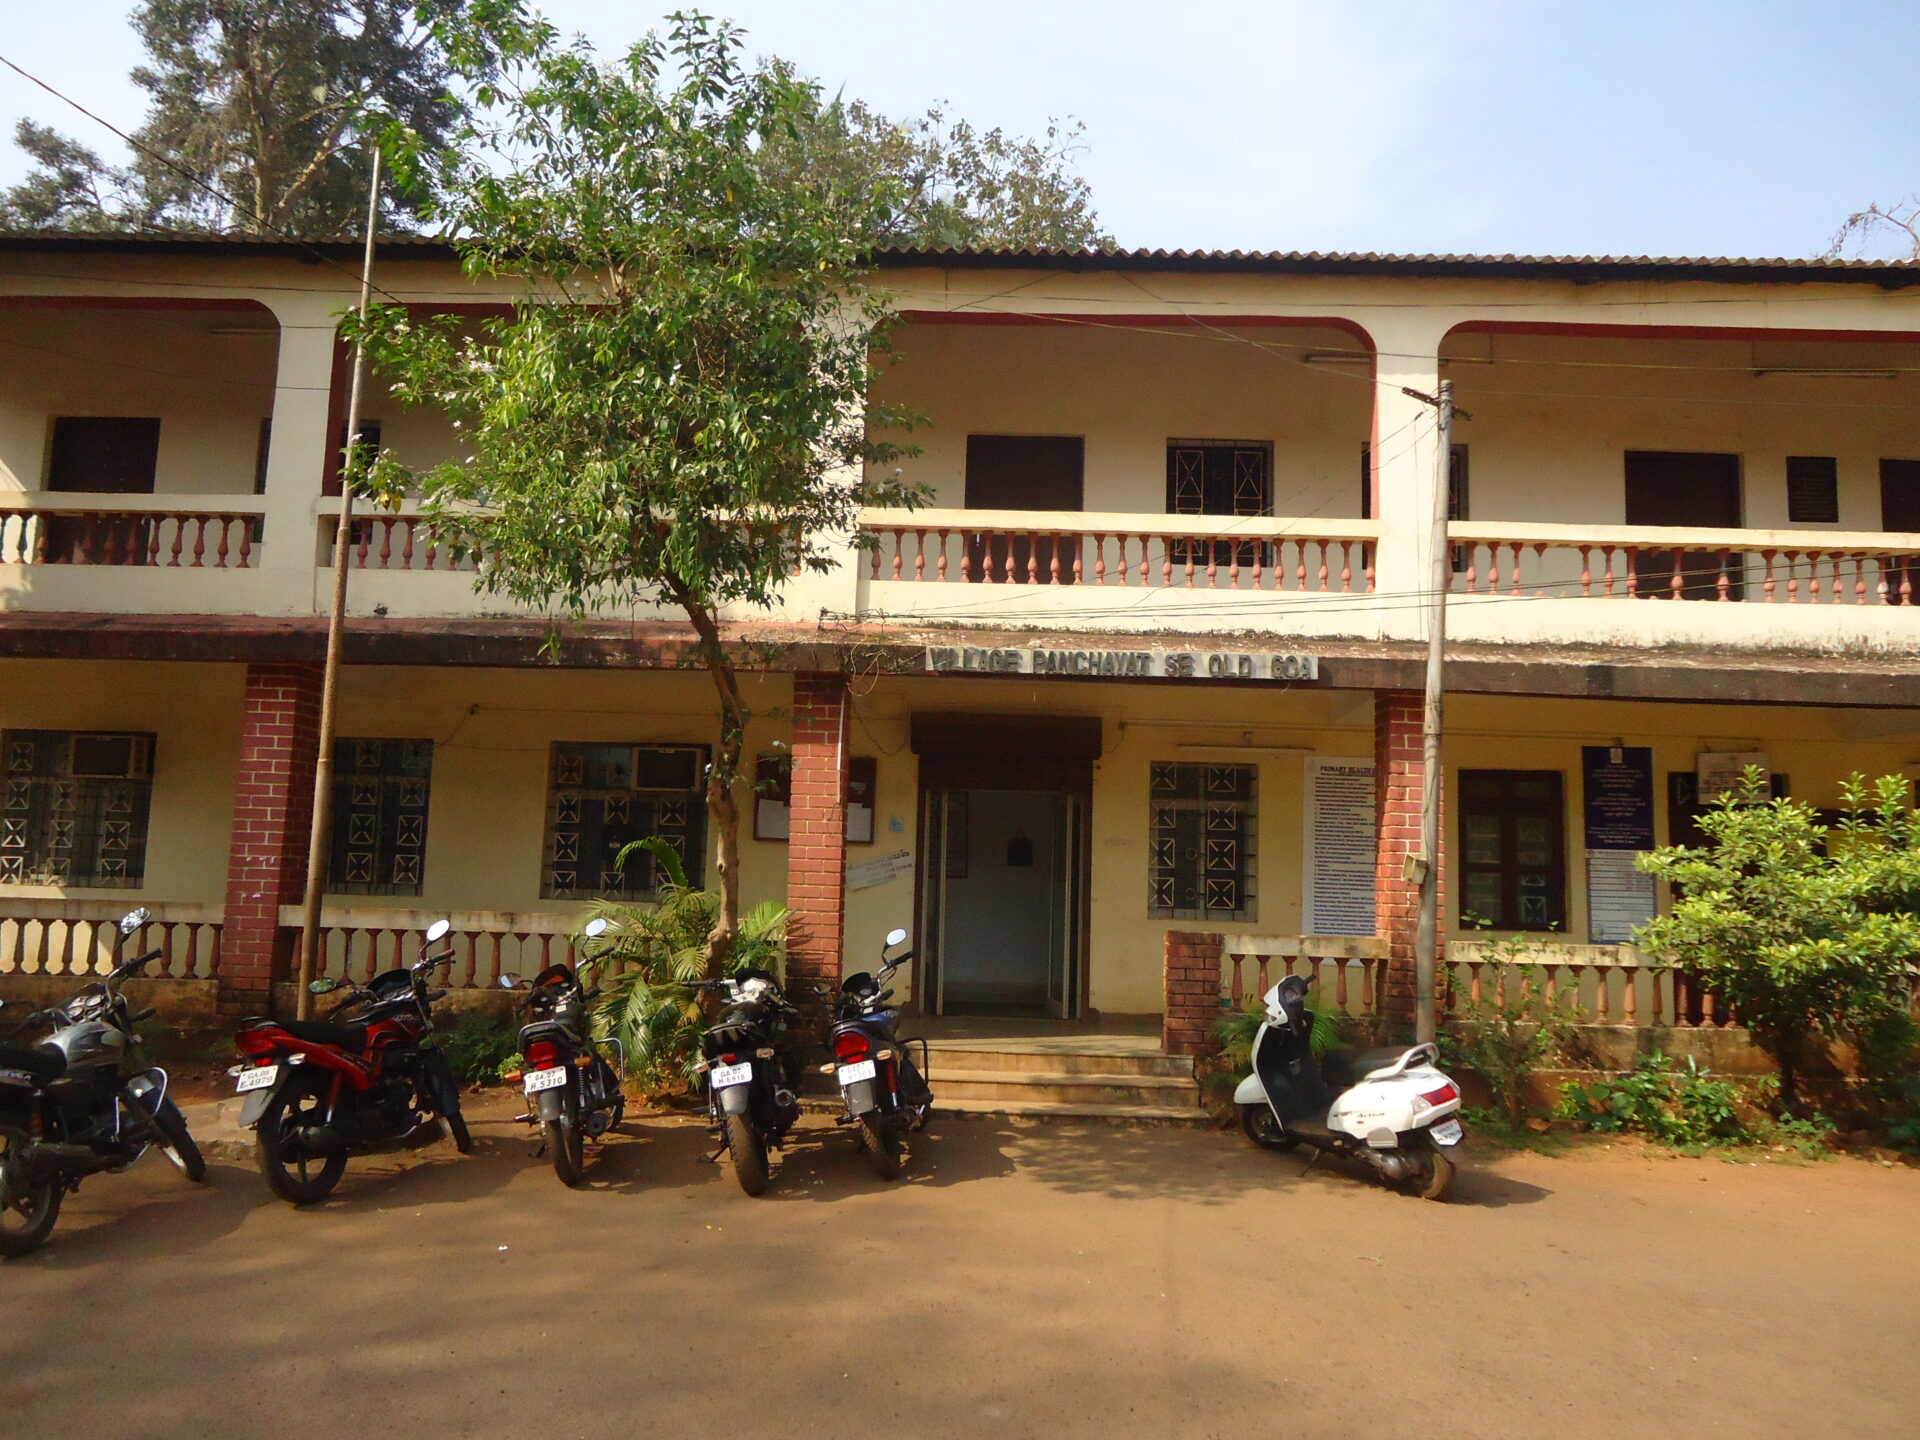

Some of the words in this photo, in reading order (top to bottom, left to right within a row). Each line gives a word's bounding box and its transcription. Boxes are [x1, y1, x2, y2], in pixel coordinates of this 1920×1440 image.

[930, 647, 1021, 673] VILLAGE
[1033, 650, 1150, 676] PANCHAYAT
[1164, 653, 1195, 678] SE
[1208, 654, 1251, 679] OLD
[1272, 655, 1312, 680] GOA
